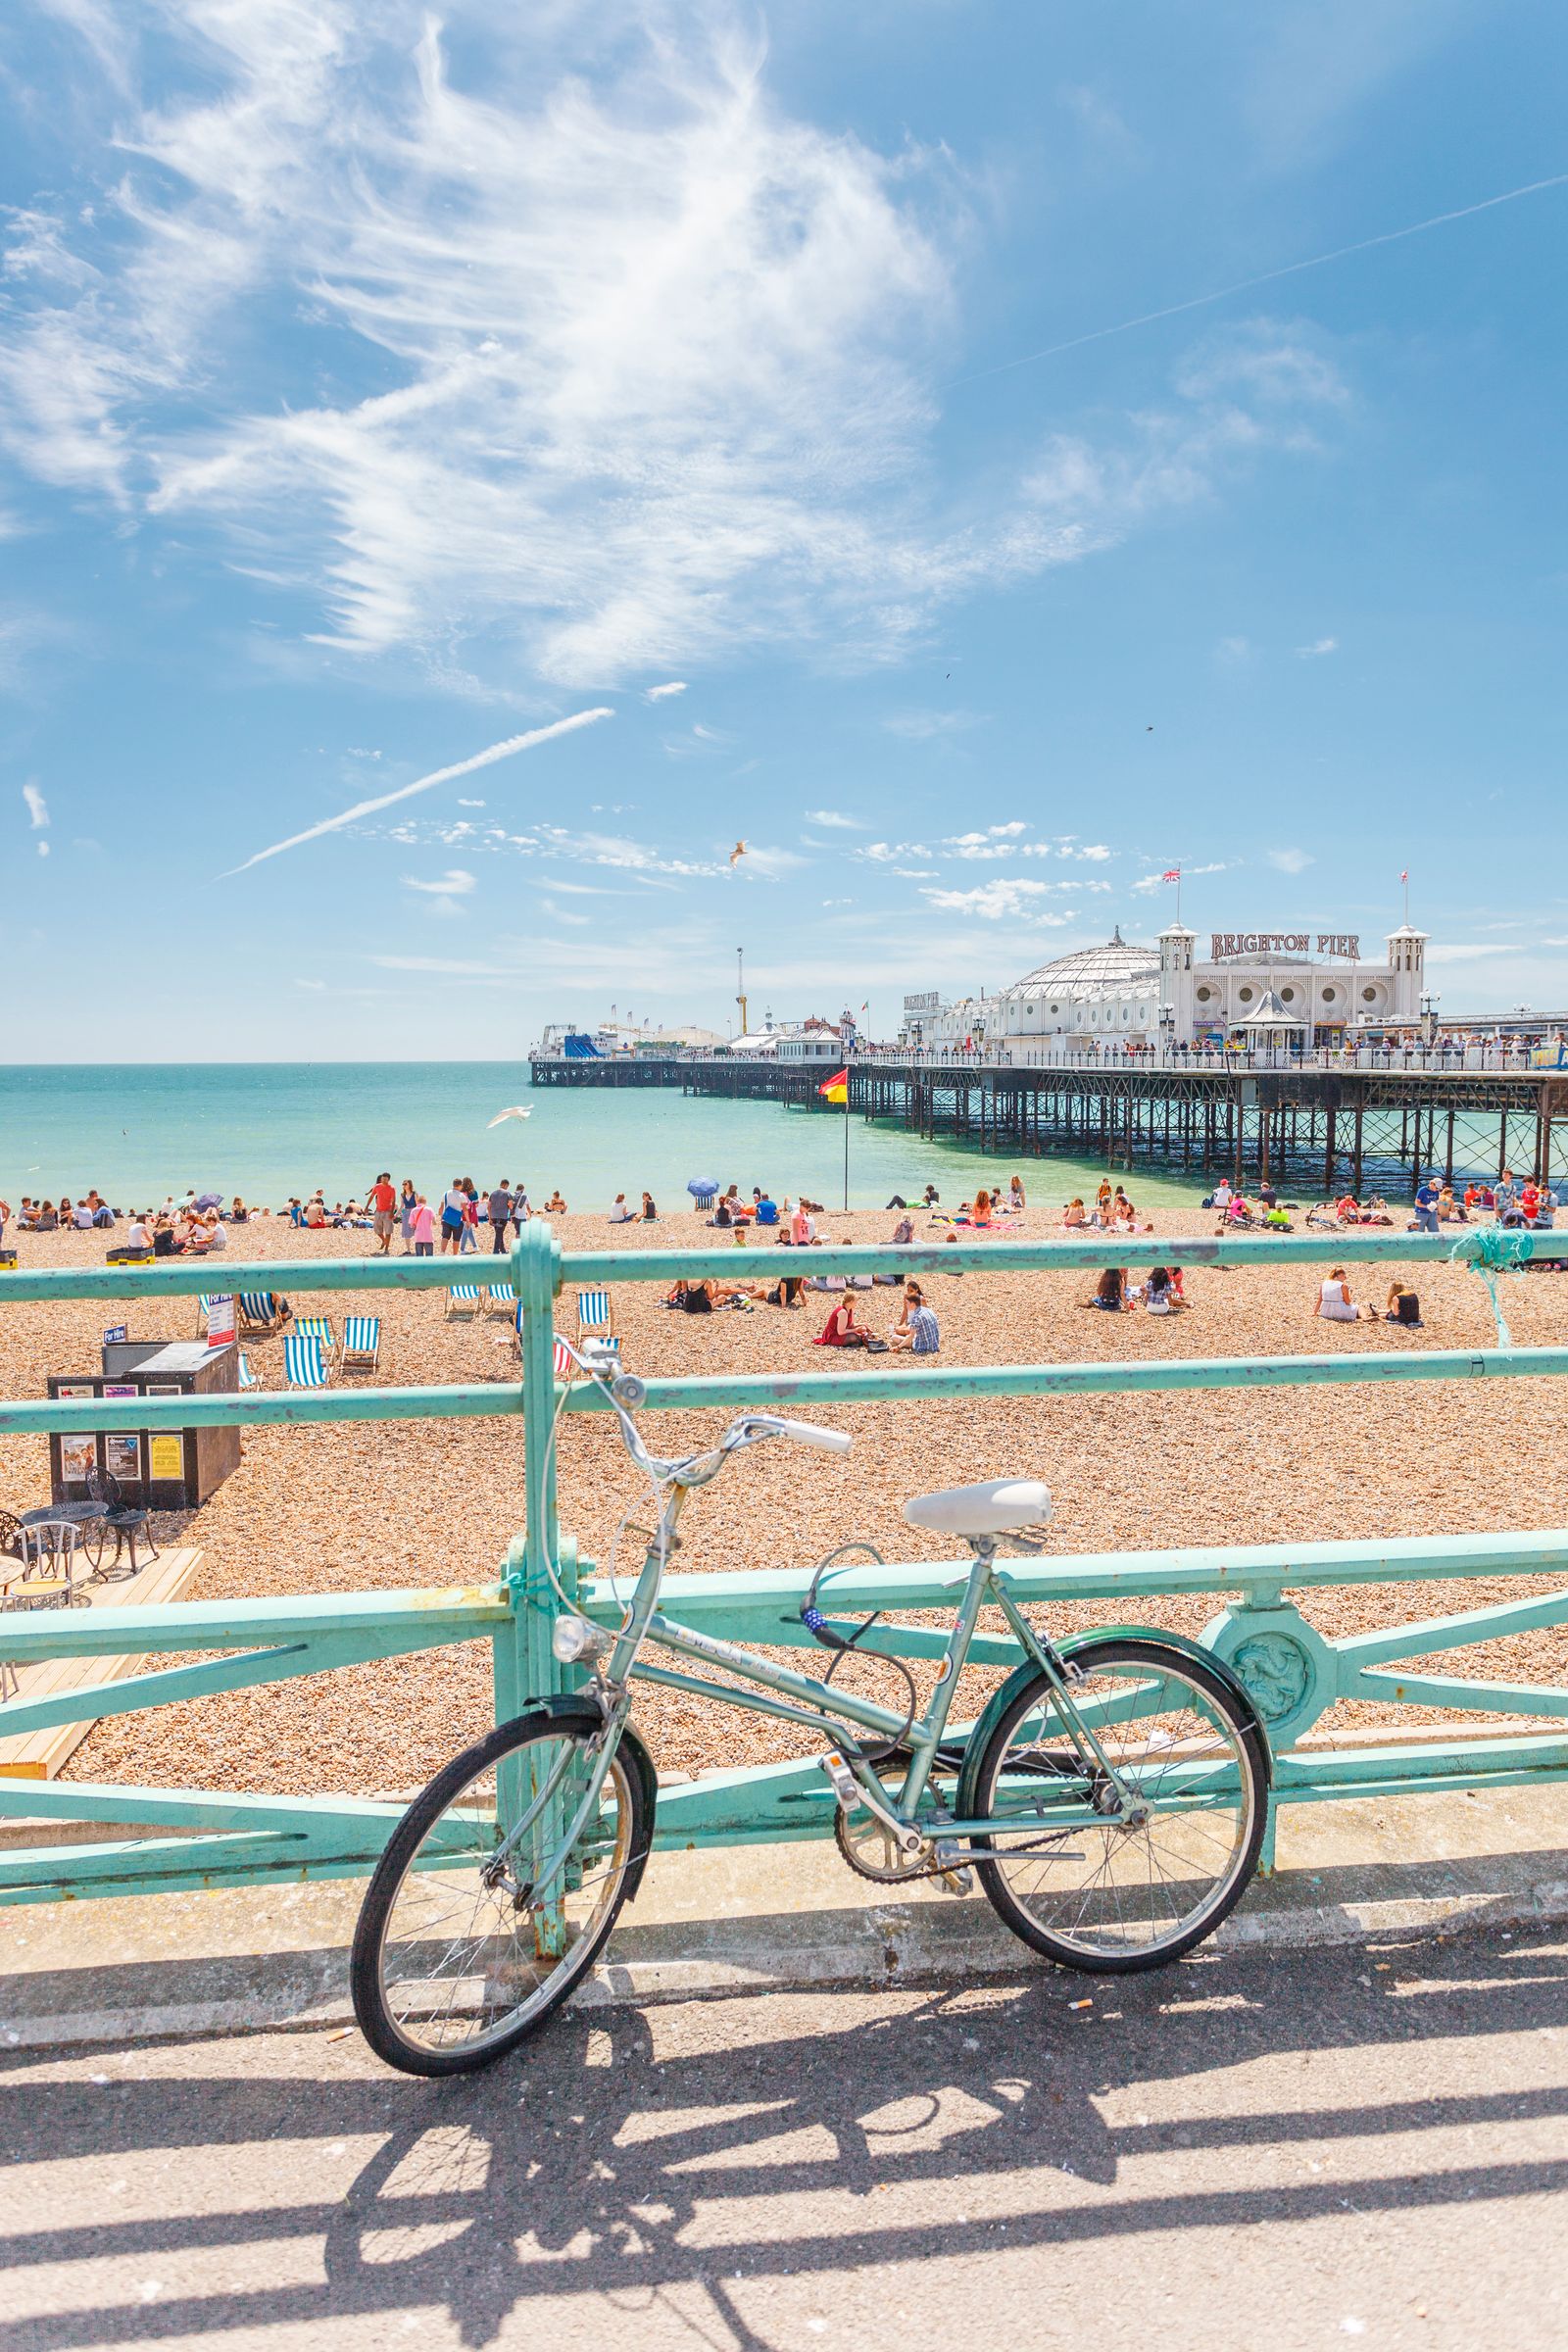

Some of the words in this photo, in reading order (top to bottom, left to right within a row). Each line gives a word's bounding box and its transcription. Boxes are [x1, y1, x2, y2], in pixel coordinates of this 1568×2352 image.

[1211, 934, 1310, 959] BRIGHTON
[1317, 934, 1361, 960] PIER
[105, 1331, 114, 1343] For
[114, 1329, 124, 1340] Hire
